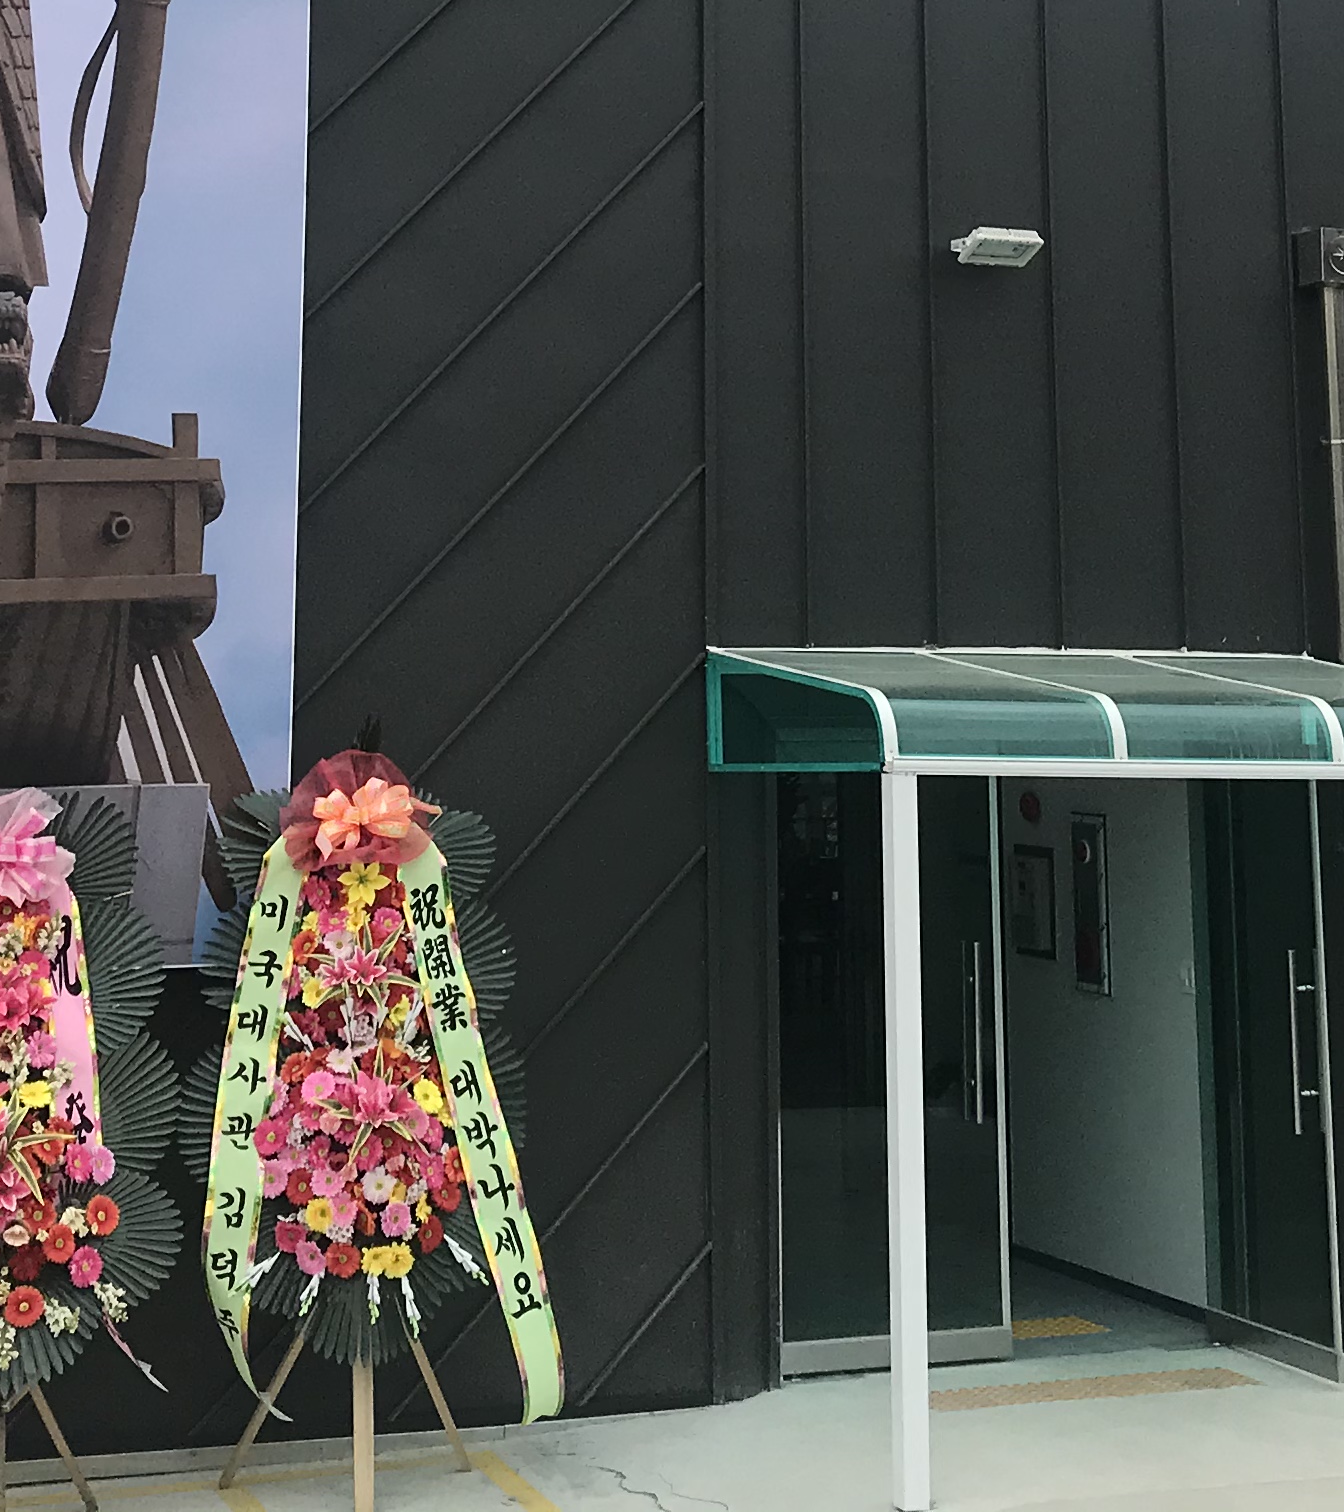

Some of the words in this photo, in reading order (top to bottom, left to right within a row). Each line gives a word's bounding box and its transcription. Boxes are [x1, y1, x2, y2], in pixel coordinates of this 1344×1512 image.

[220, 894, 283, 1151] 미국대사관
[409, 883, 468, 1033] 祝開業
[449, 1059, 543, 1320] 대박나세요
